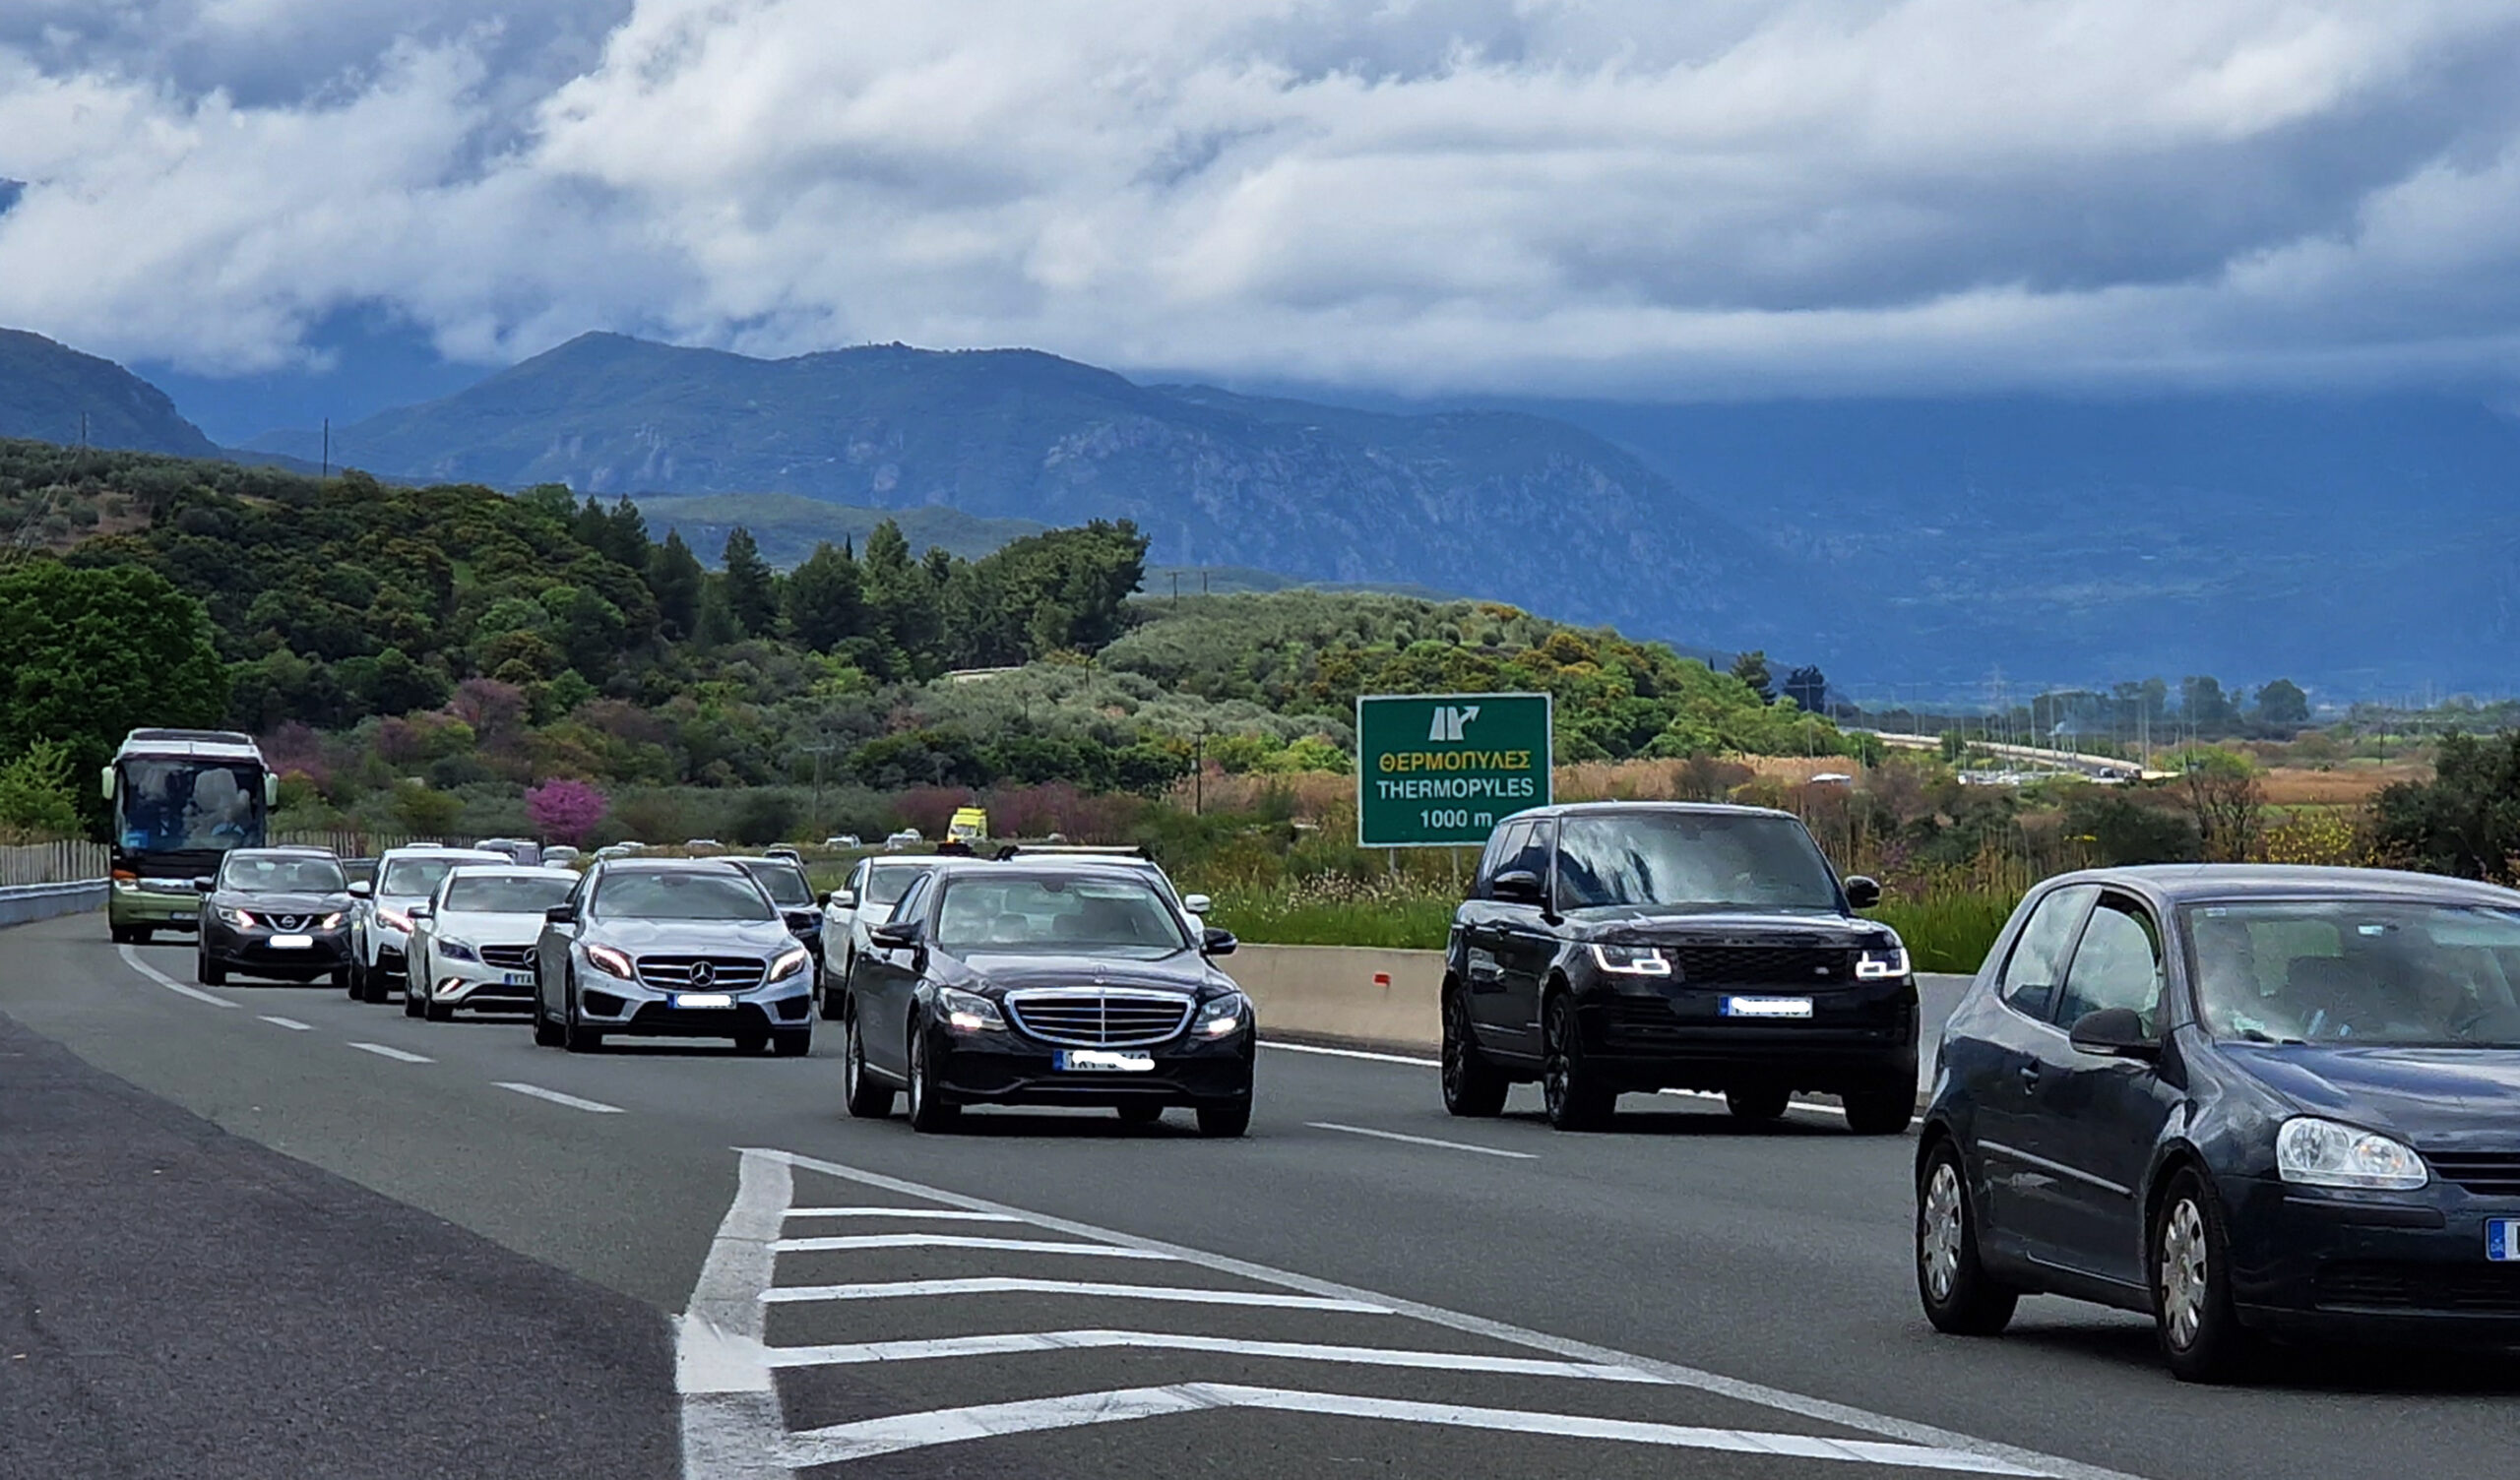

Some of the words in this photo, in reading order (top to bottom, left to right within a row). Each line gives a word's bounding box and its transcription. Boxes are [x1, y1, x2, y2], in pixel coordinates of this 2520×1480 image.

[1379, 751, 1531, 772] ΘΕΡΜΟΠΥΛΕΣ
[1376, 777, 1534, 799] THERMOPYLES
[1420, 809, 1468, 829] 1000
[1474, 811, 1492, 828] m
